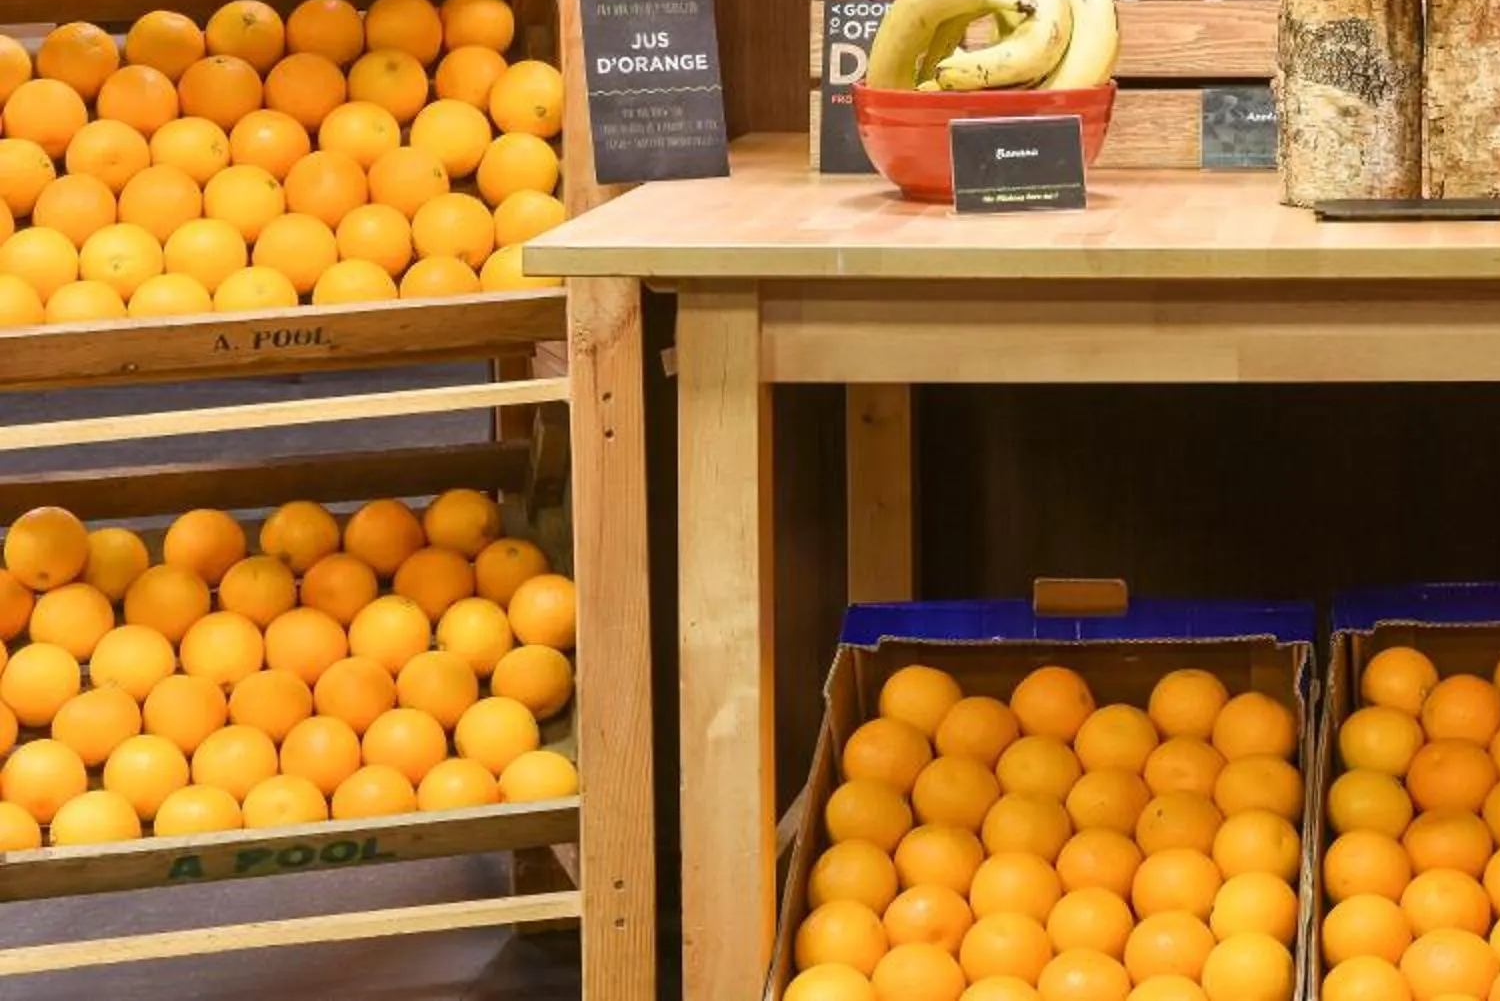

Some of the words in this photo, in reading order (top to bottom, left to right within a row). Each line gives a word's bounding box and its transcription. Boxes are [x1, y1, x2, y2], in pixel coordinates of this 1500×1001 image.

[843, 21, 879, 40] OF
[631, 32, 670, 50] JUS
[596, 54, 710, 75] D'ORANGE
[831, 95, 853, 105] FRO
[168, 855, 204, 879] A
[235, 837, 397, 874] POOL
